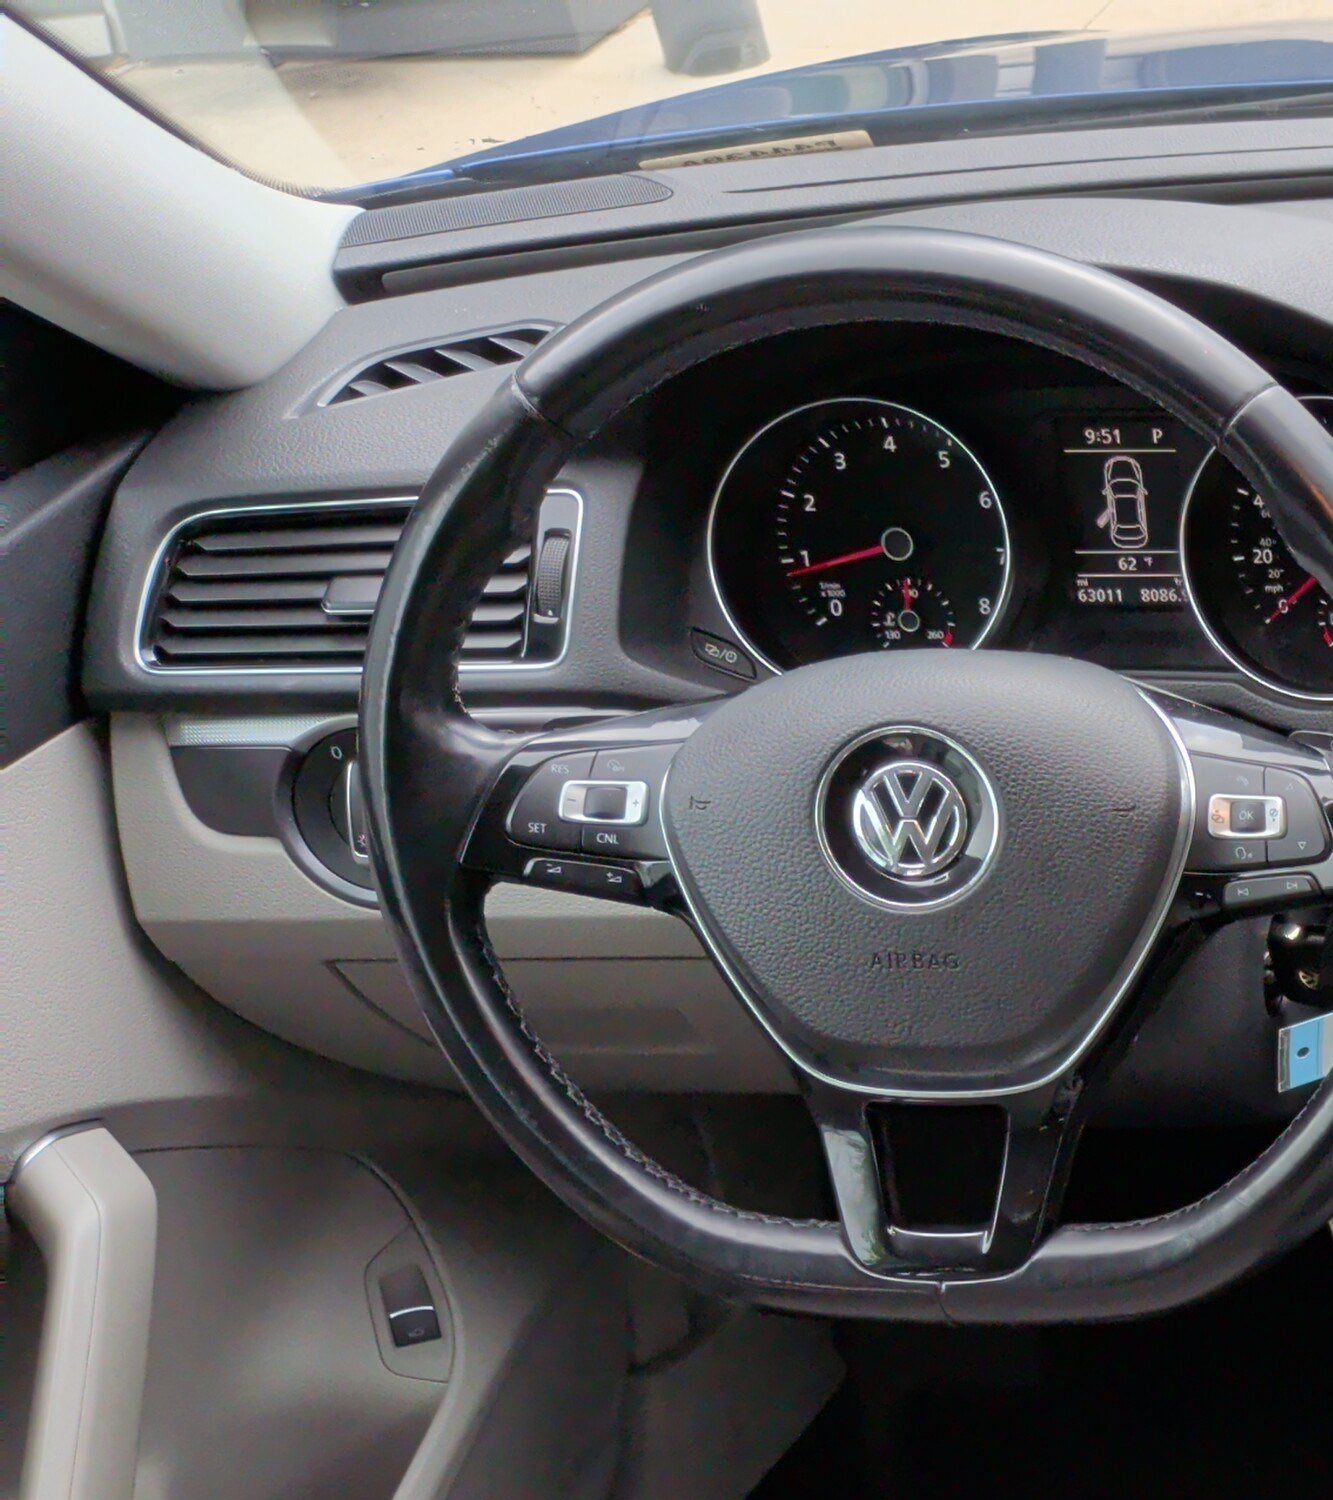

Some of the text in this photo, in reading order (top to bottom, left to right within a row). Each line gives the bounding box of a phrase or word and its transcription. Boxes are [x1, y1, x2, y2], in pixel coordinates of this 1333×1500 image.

[883, 436, 896, 452] 4
[1084, 428, 1163, 444] 9:51 P
[835, 453, 847, 470] 3
[938, 451, 950, 469] 5
[804, 495, 817, 513] 2
[980, 492, 992, 509] 6
[800, 550, 811, 568] 1
[1118, 557, 1137, 571] 62
[1252, 549, 1273, 564] 20
[1268, 569, 1281, 579] 20
[1078, 588, 1123, 603] 63011
[1264, 583, 1284, 593] mph
[830, 599, 842, 616] 0
[979, 598, 991, 615] 8
[551, 763, 570, 774] RES
[1239, 810, 1255, 821] OK
[528, 822, 547, 835] SET
[596, 832, 620, 845] CNL
[870, 949, 961, 971] AIRBAG
